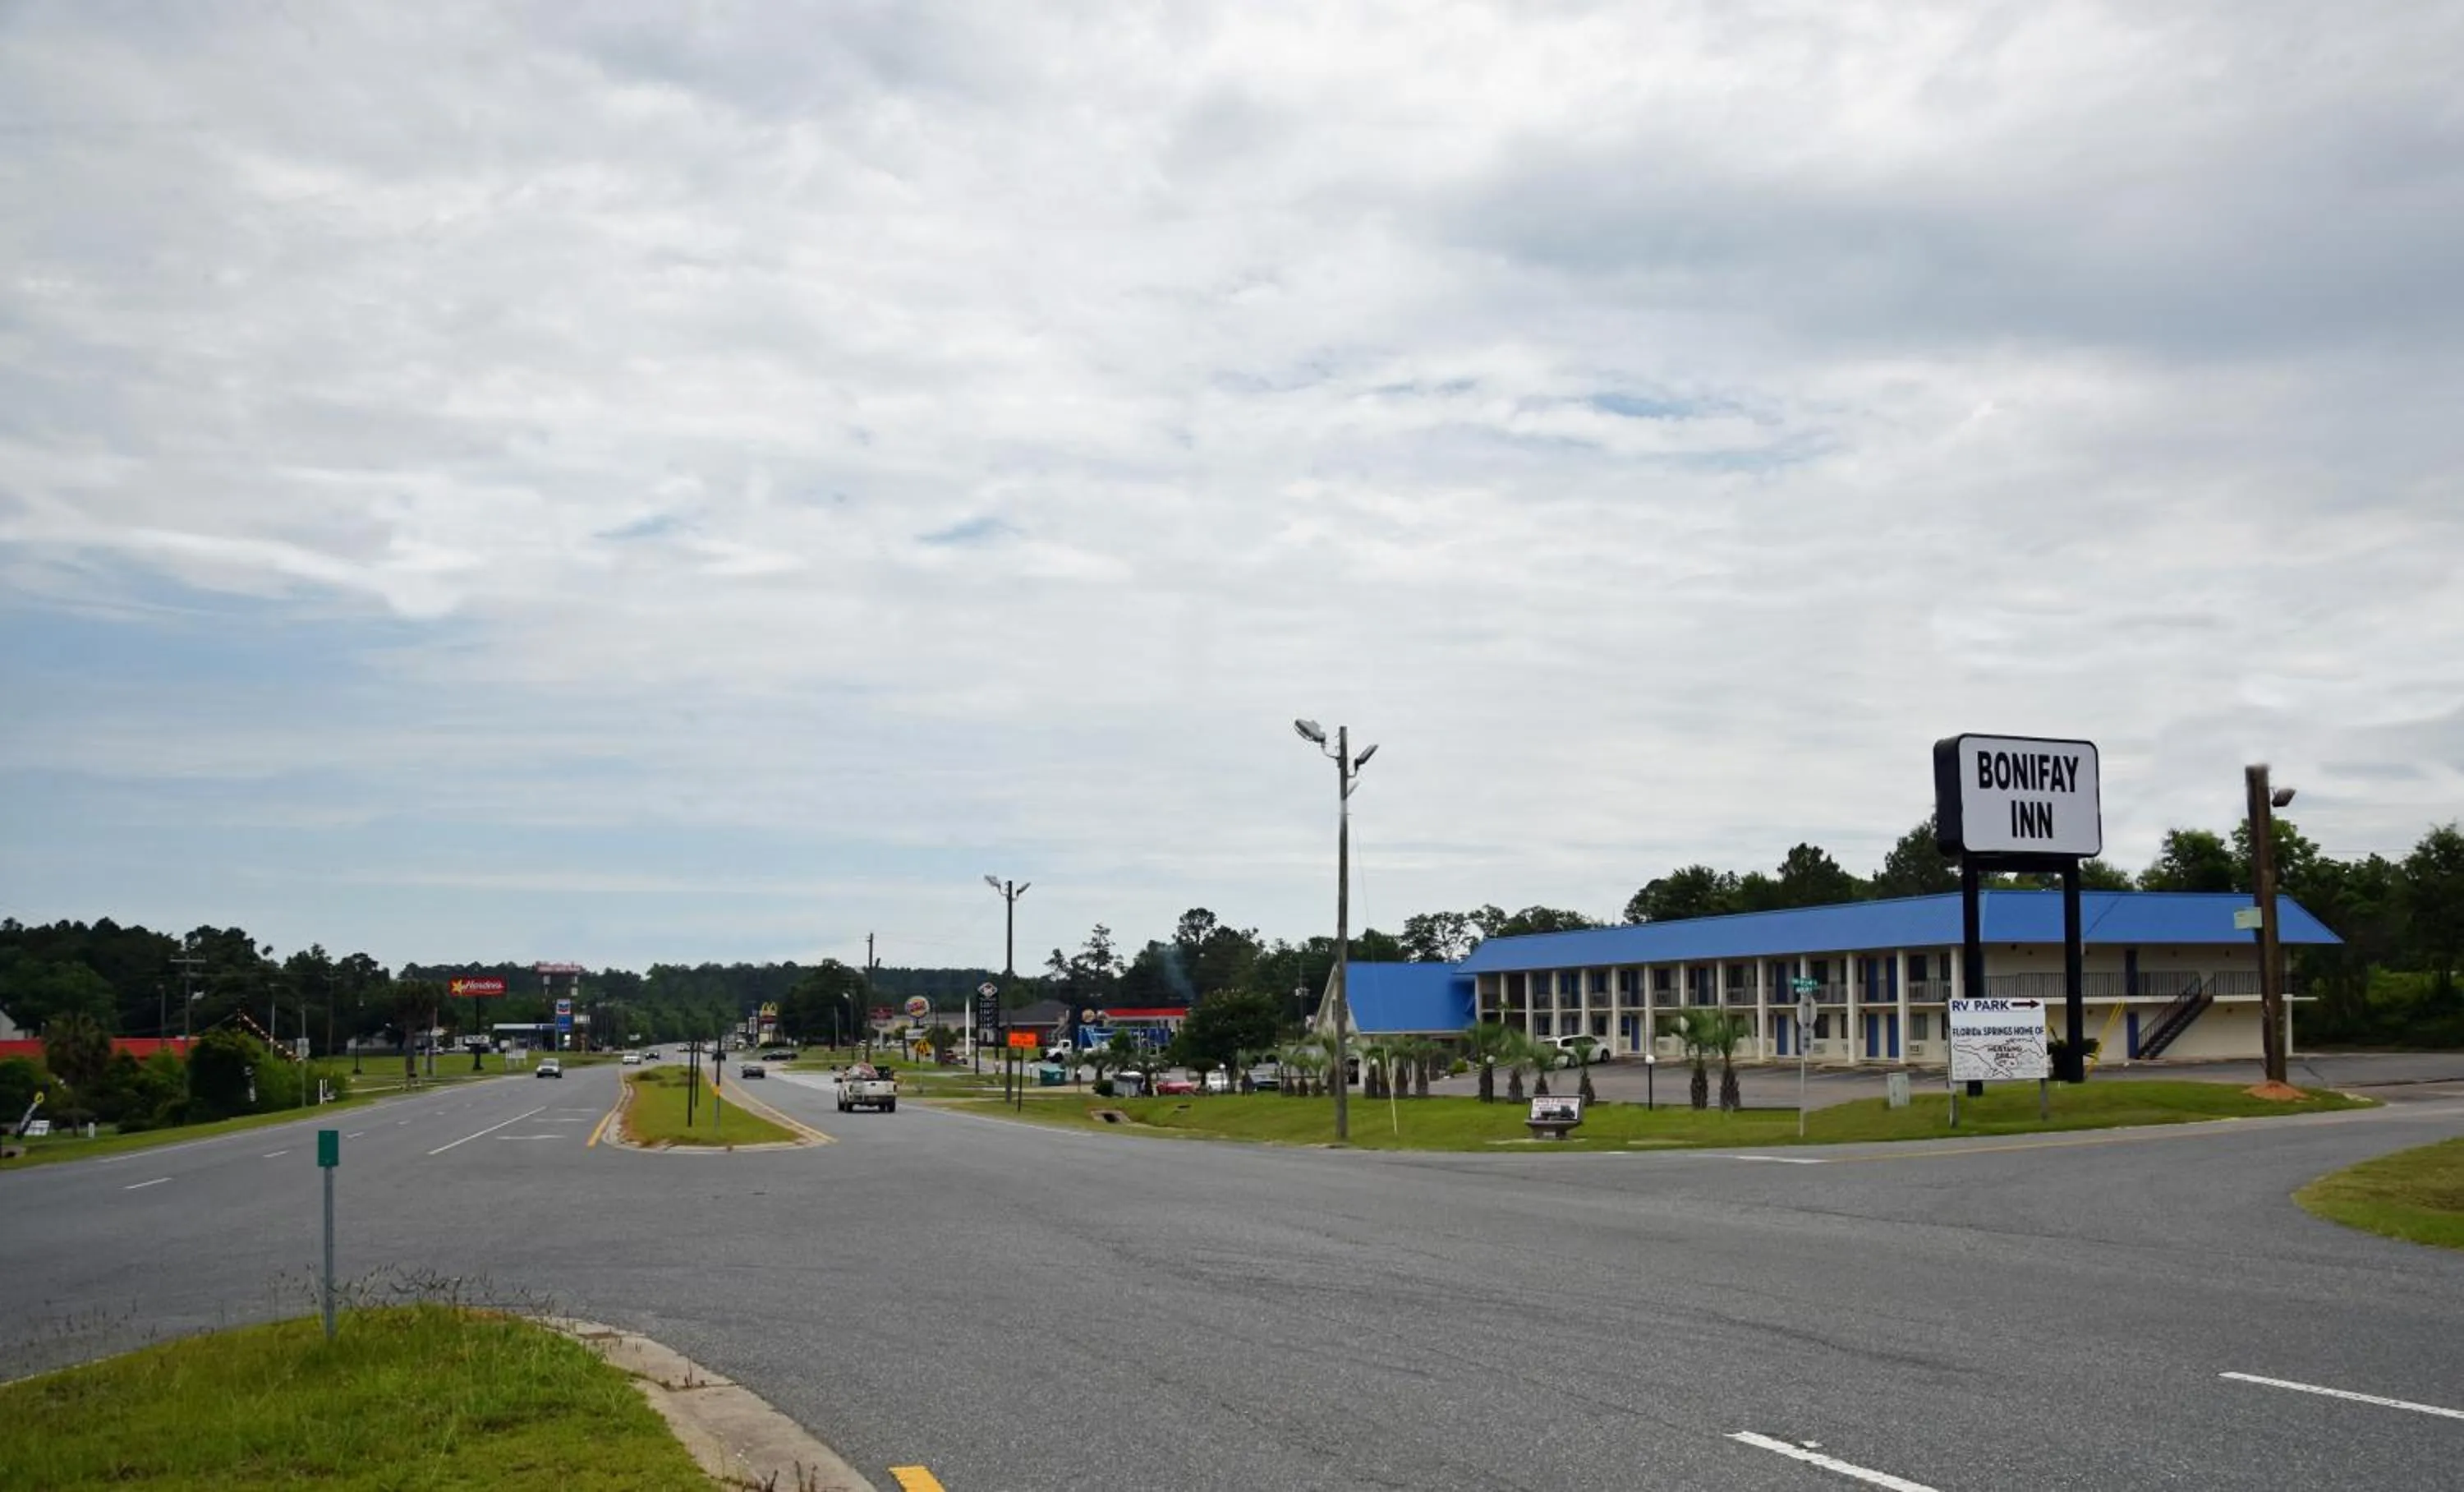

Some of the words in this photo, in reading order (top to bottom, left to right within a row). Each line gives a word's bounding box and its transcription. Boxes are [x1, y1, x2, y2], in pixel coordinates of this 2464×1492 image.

[1977, 751, 2079, 793] BONIFAY
[2011, 799, 2053, 839] INN
[1951, 1000, 1969, 1011] RV
[1974, 1000, 2009, 1011] PARK
[1984, 1026, 2013, 1036] SPRINGS
[2013, 1025, 2034, 1035] HOME
[2034, 1025, 2045, 1035] OF
